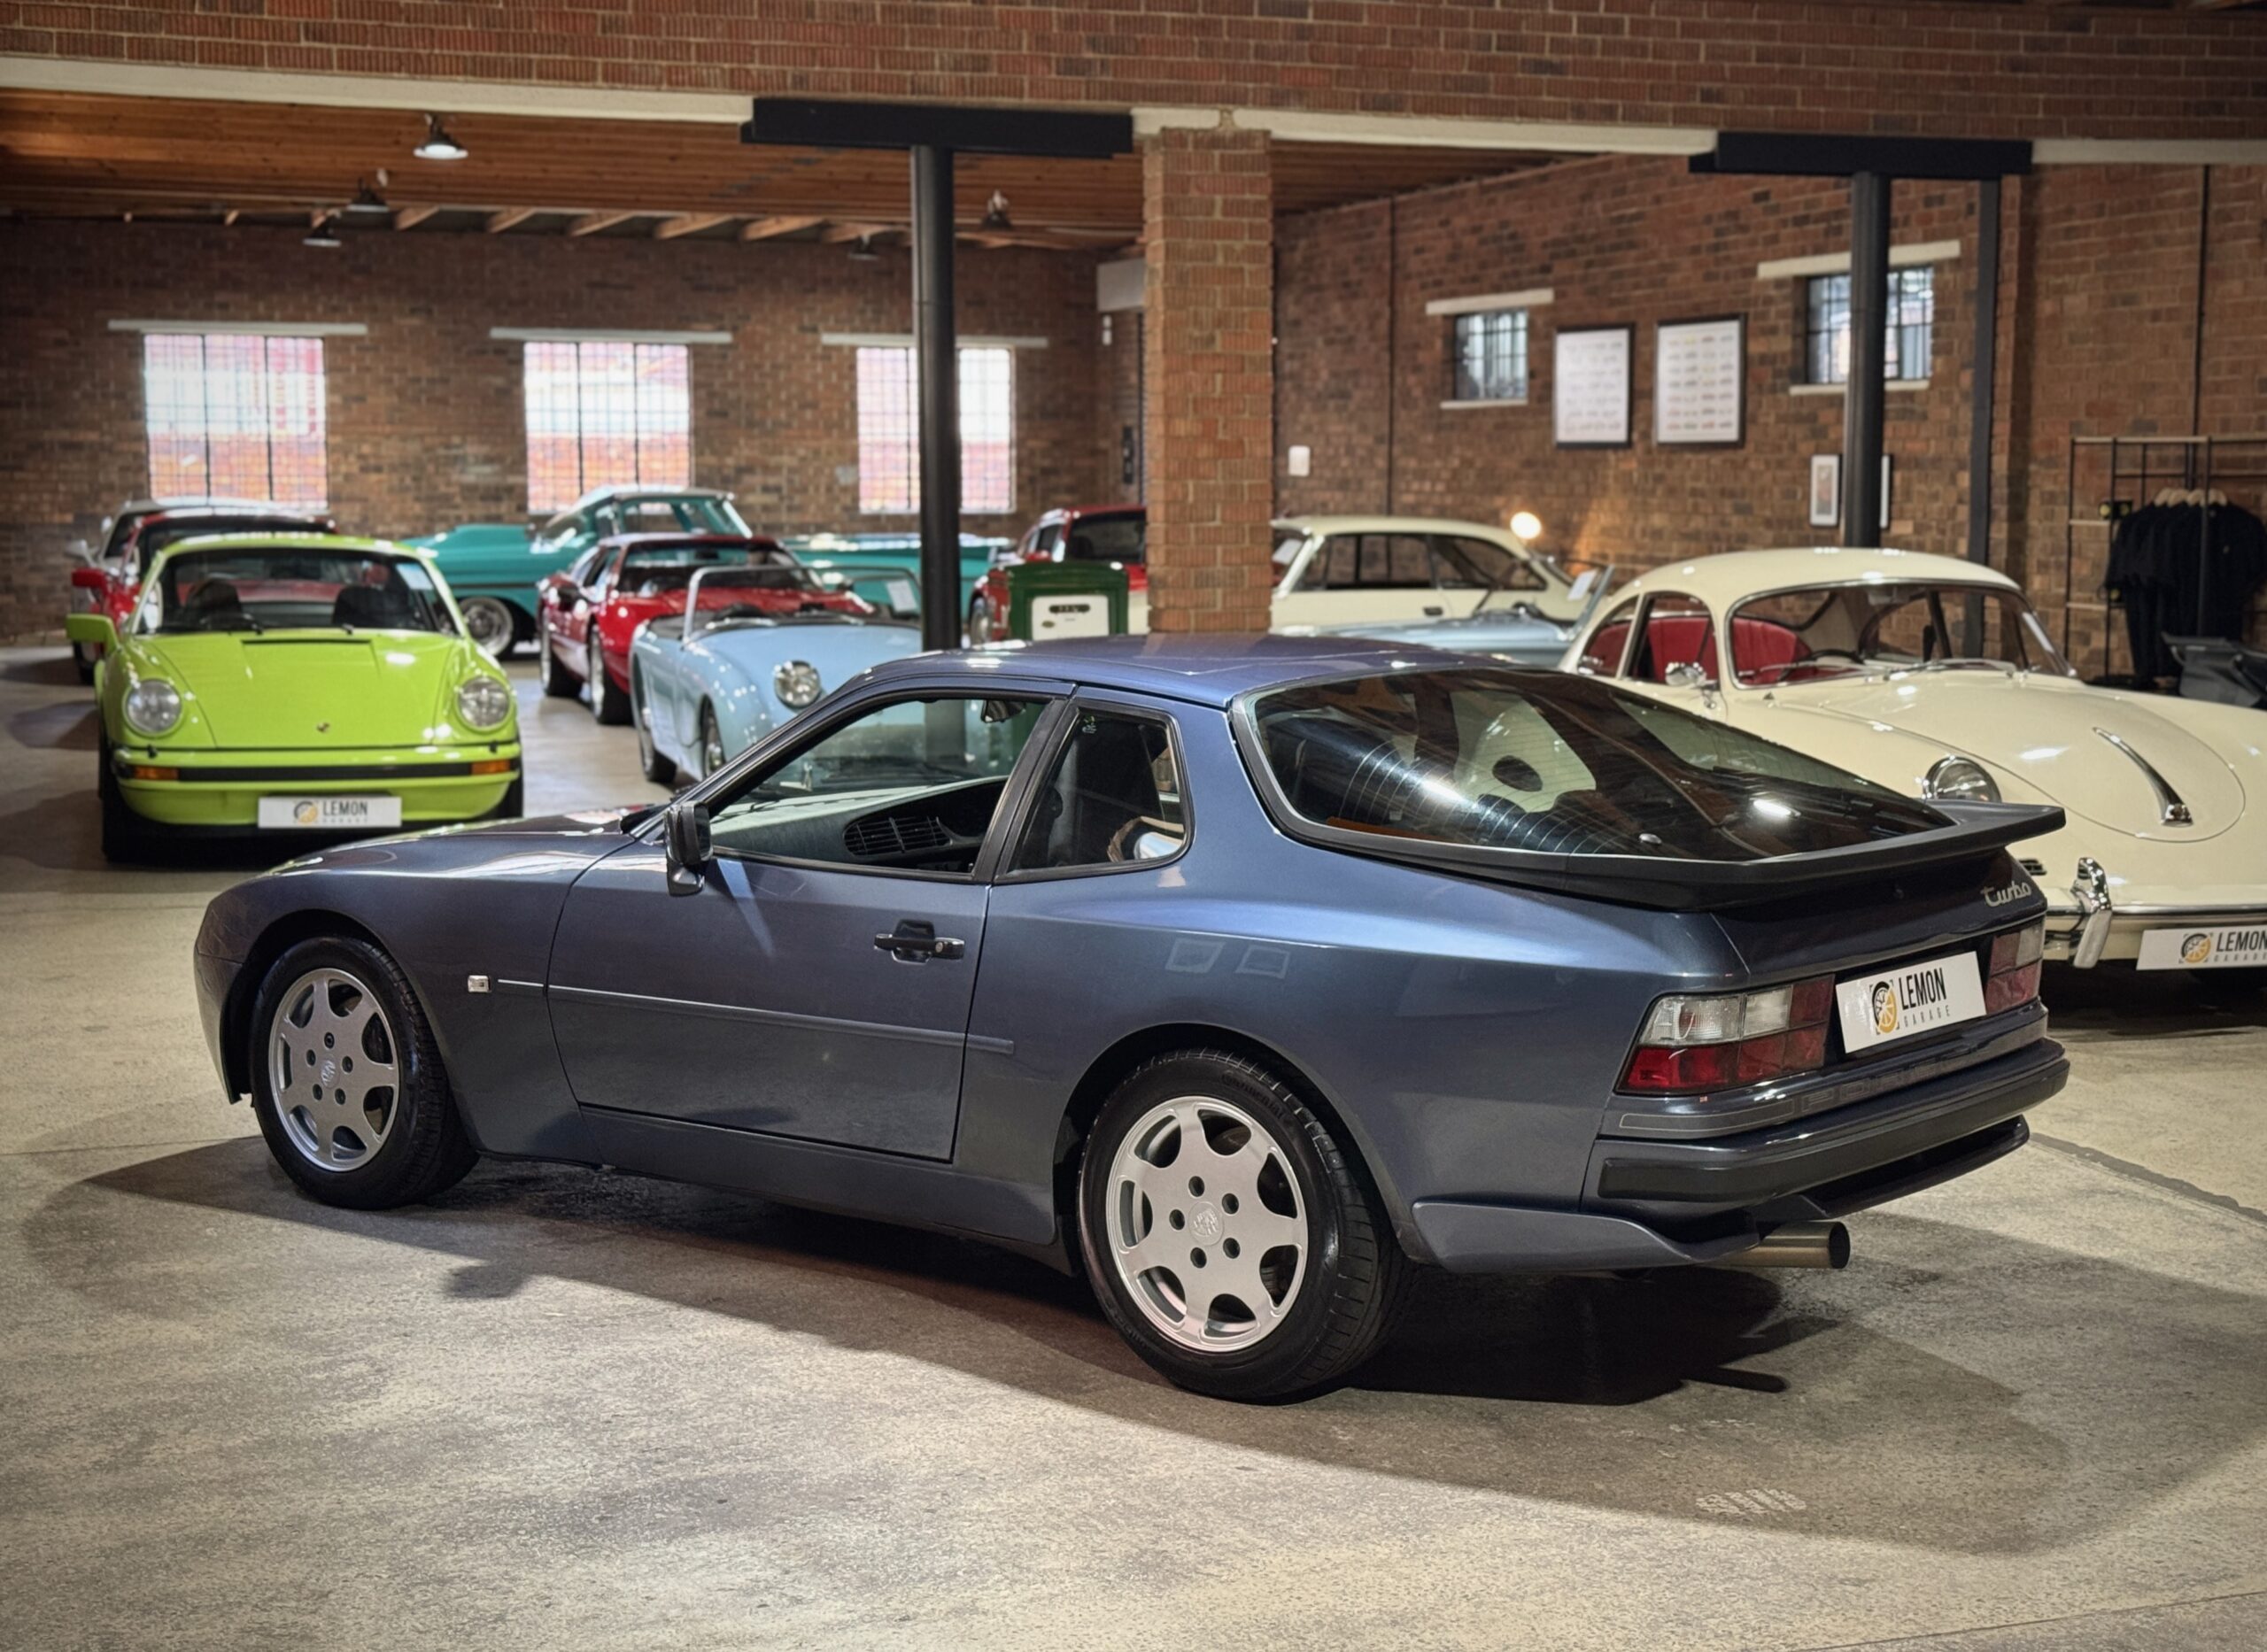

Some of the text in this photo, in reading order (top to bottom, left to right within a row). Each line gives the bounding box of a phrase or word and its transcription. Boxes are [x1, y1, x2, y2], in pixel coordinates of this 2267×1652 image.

[322, 800, 368, 816] LEMON
[2216, 930, 2267, 953] LEMON
[1898, 967, 1947, 1011] LEMON
[1904, 1004, 1951, 1028] GARAGE
